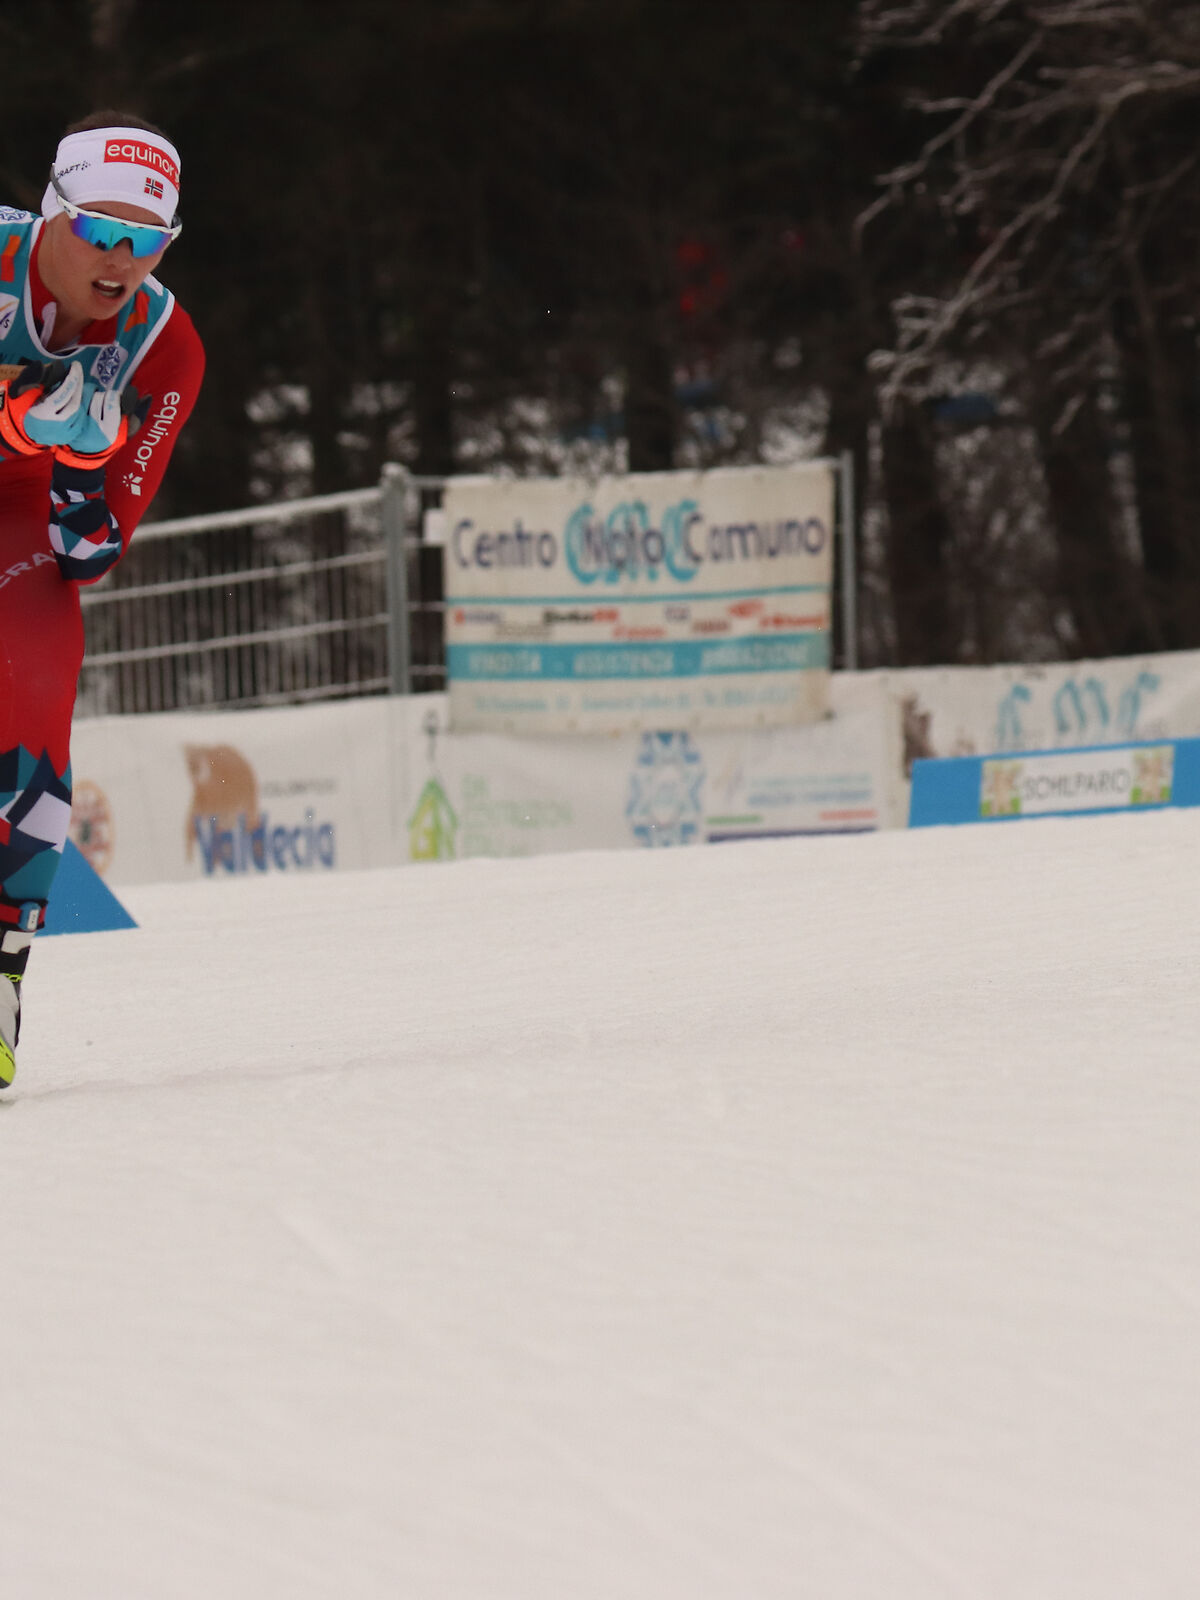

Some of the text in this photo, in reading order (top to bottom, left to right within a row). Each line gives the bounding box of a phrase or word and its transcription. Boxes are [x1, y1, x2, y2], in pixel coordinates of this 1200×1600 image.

[106, 143, 175, 176] equinor
[134, 391, 181, 472] equinor
[452, 518, 558, 568] Centro
[685, 513, 827, 562] Camuno
[194, 807, 337, 877] Valdecia
